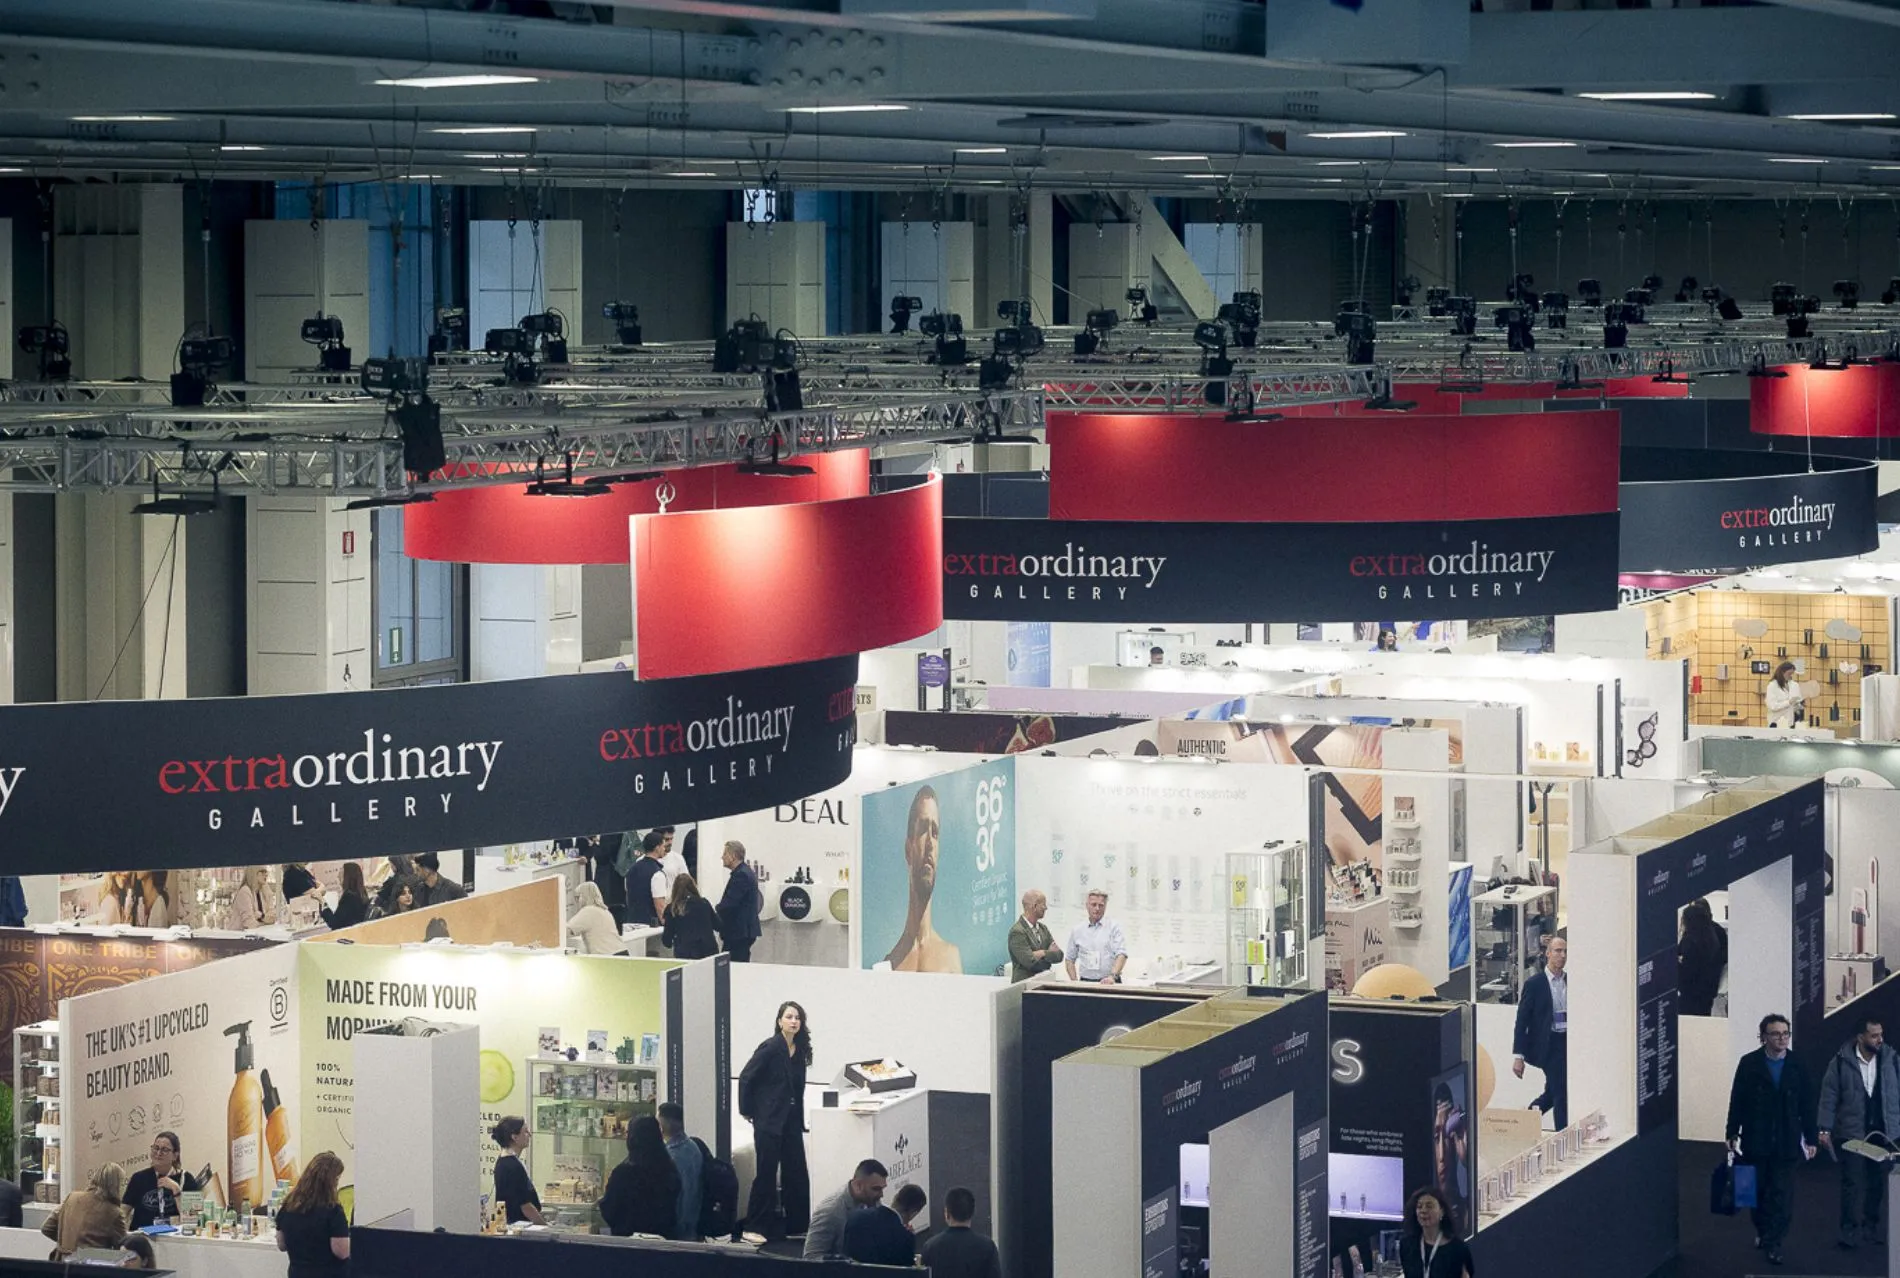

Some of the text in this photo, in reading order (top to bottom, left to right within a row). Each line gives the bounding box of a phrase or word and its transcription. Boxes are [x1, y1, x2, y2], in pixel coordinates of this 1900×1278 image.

[1721, 495, 1836, 530] extraordinary
[1739, 529, 1823, 548] GALLERY
[944, 542, 1167, 588] extraordinary
[1349, 541, 1555, 582] extraordinary
[969, 584, 1127, 601] GALLERY
[1379, 581, 1523, 600] GALLERY
[600, 696, 796, 762] extraordinary
[1177, 739, 1226, 754] AUTHENTIC
[159, 728, 503, 794] extraordinary
[634, 755, 774, 794] GALLERY
[208, 793, 452, 831] GALLERY
[53, 941, 158, 960] ONE TRIBE
[326, 979, 477, 1011] MADE FROM YOUR
[86, 1003, 208, 1058] THE UK'S #1 UPCYCLED
[86, 1052, 173, 1099] BEAUTY BRAND.
[316, 1063, 341, 1072] 100%
[316, 1105, 352, 1115] ORGANIC
